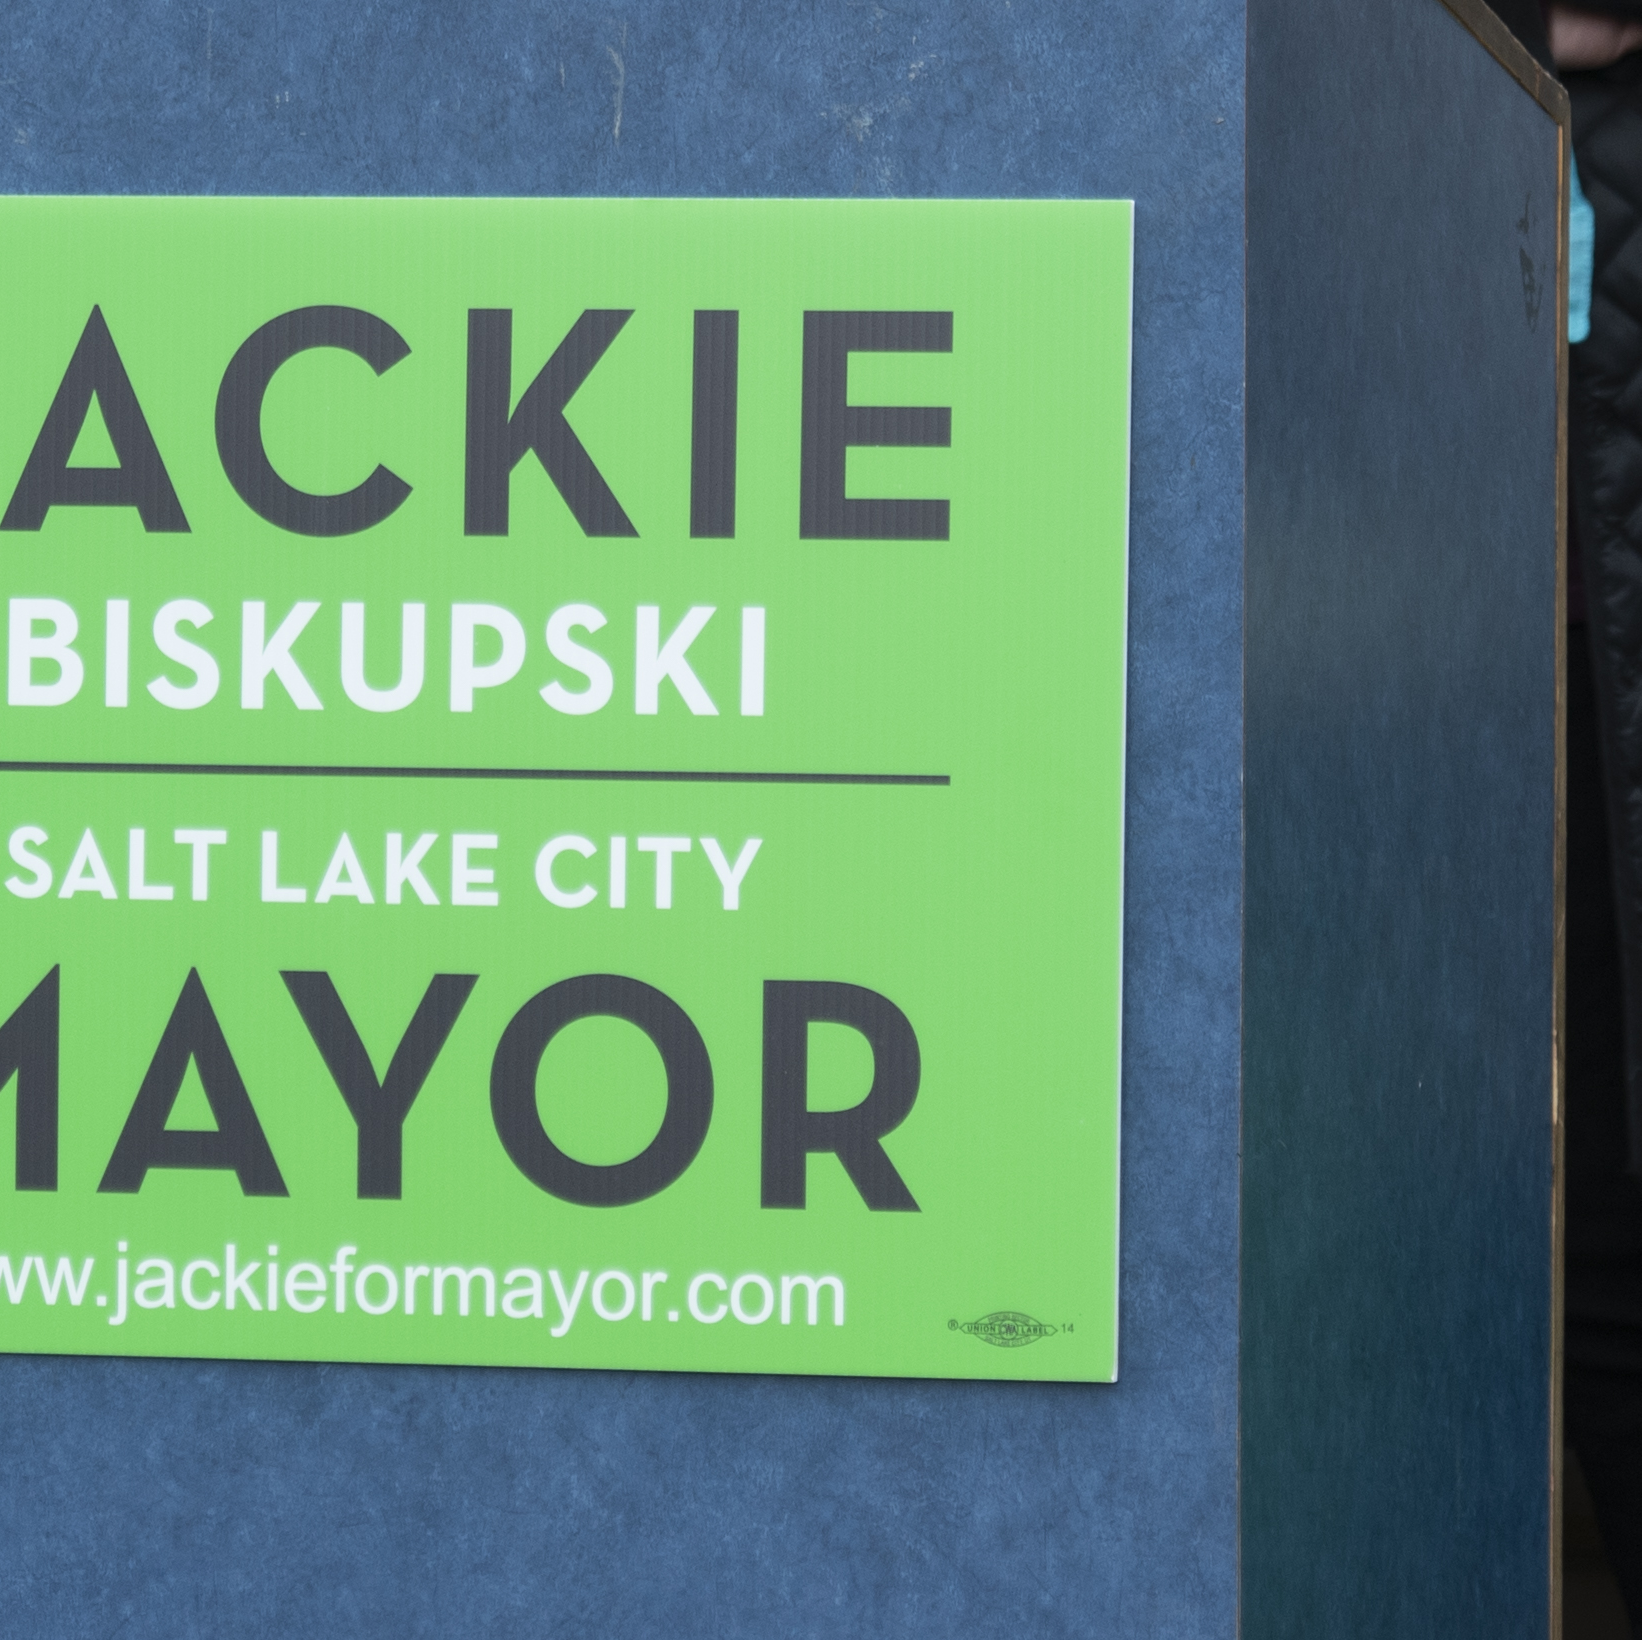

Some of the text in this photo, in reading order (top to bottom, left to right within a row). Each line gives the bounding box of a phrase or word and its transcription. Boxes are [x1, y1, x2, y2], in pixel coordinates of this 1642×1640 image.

[6, 595, 768, 717] BISKUPSKI
[3, 823, 764, 911] SALT LAKE CITY
[966, 1324, 996, 1334] UNION
[1061, 1323, 1075, 1334] 14
